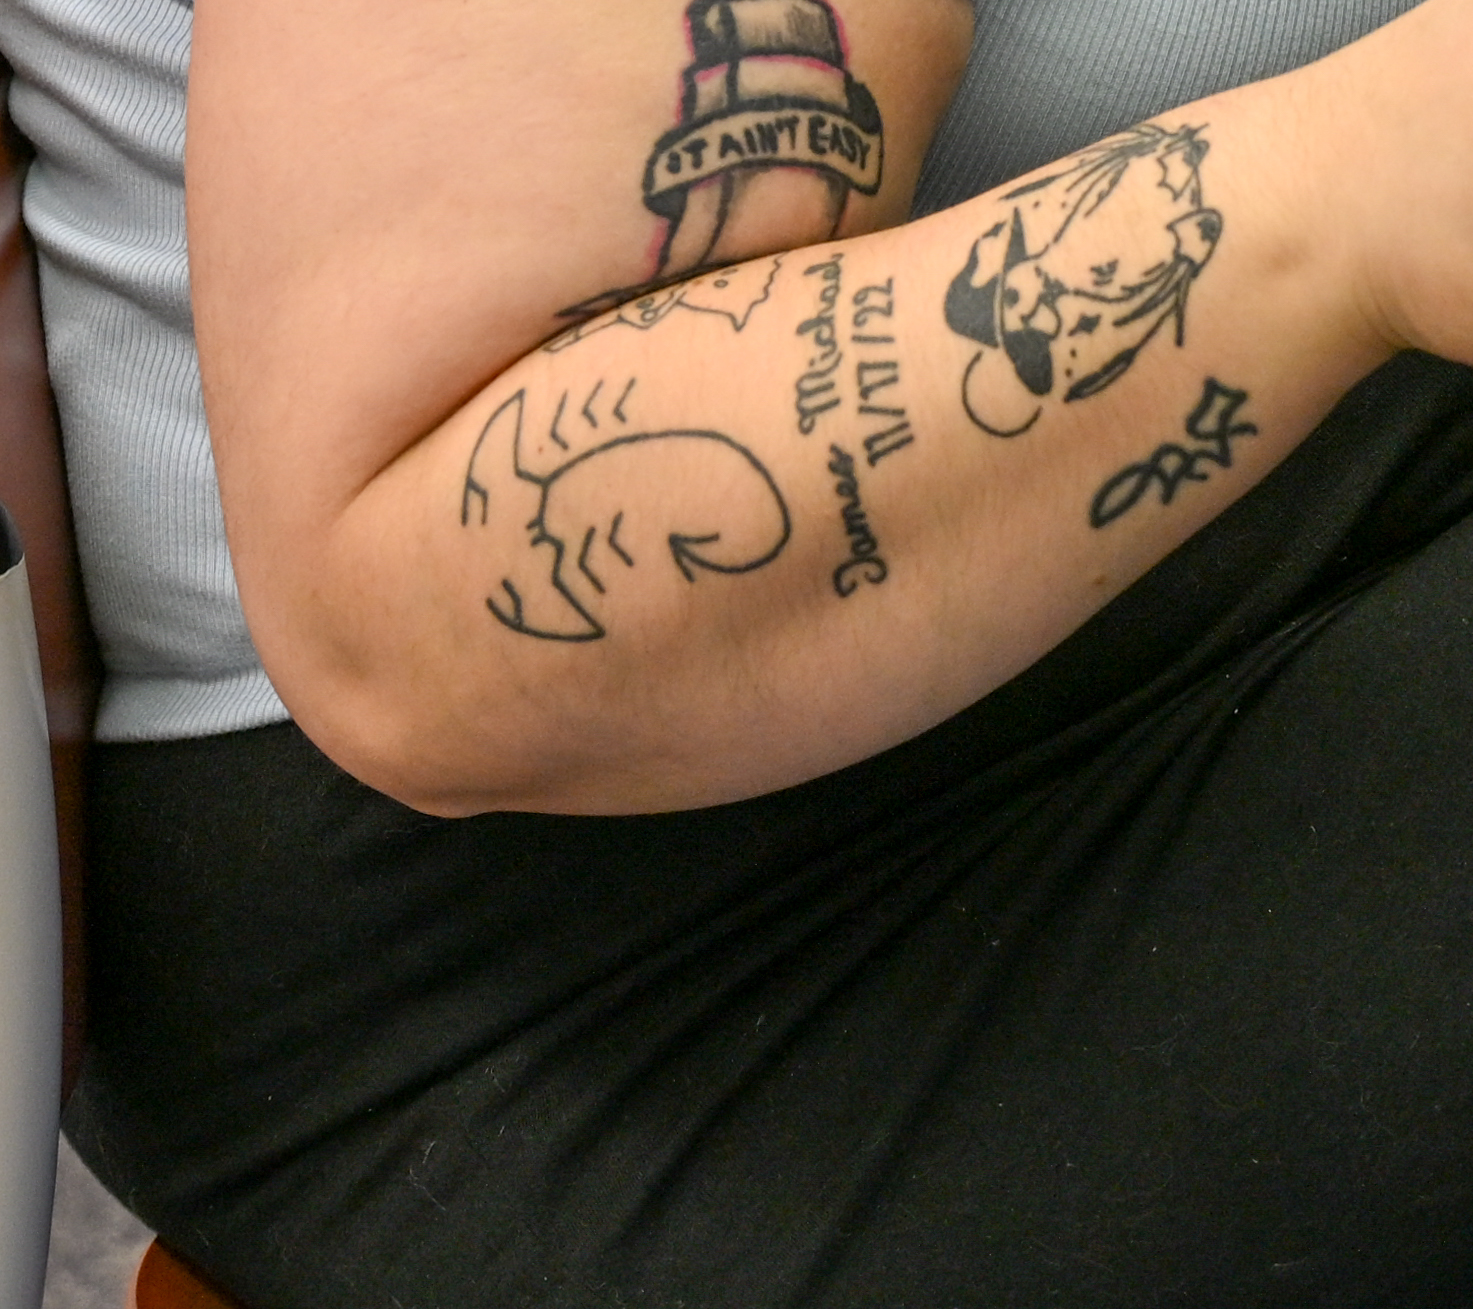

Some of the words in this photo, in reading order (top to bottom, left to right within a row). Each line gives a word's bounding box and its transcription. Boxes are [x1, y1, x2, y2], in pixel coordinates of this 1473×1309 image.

[719, 114, 800, 159] AIN'T
[808, 113, 871, 171] EASY
[794, 252, 845, 436] Michael
[827, 442, 888, 598] James
